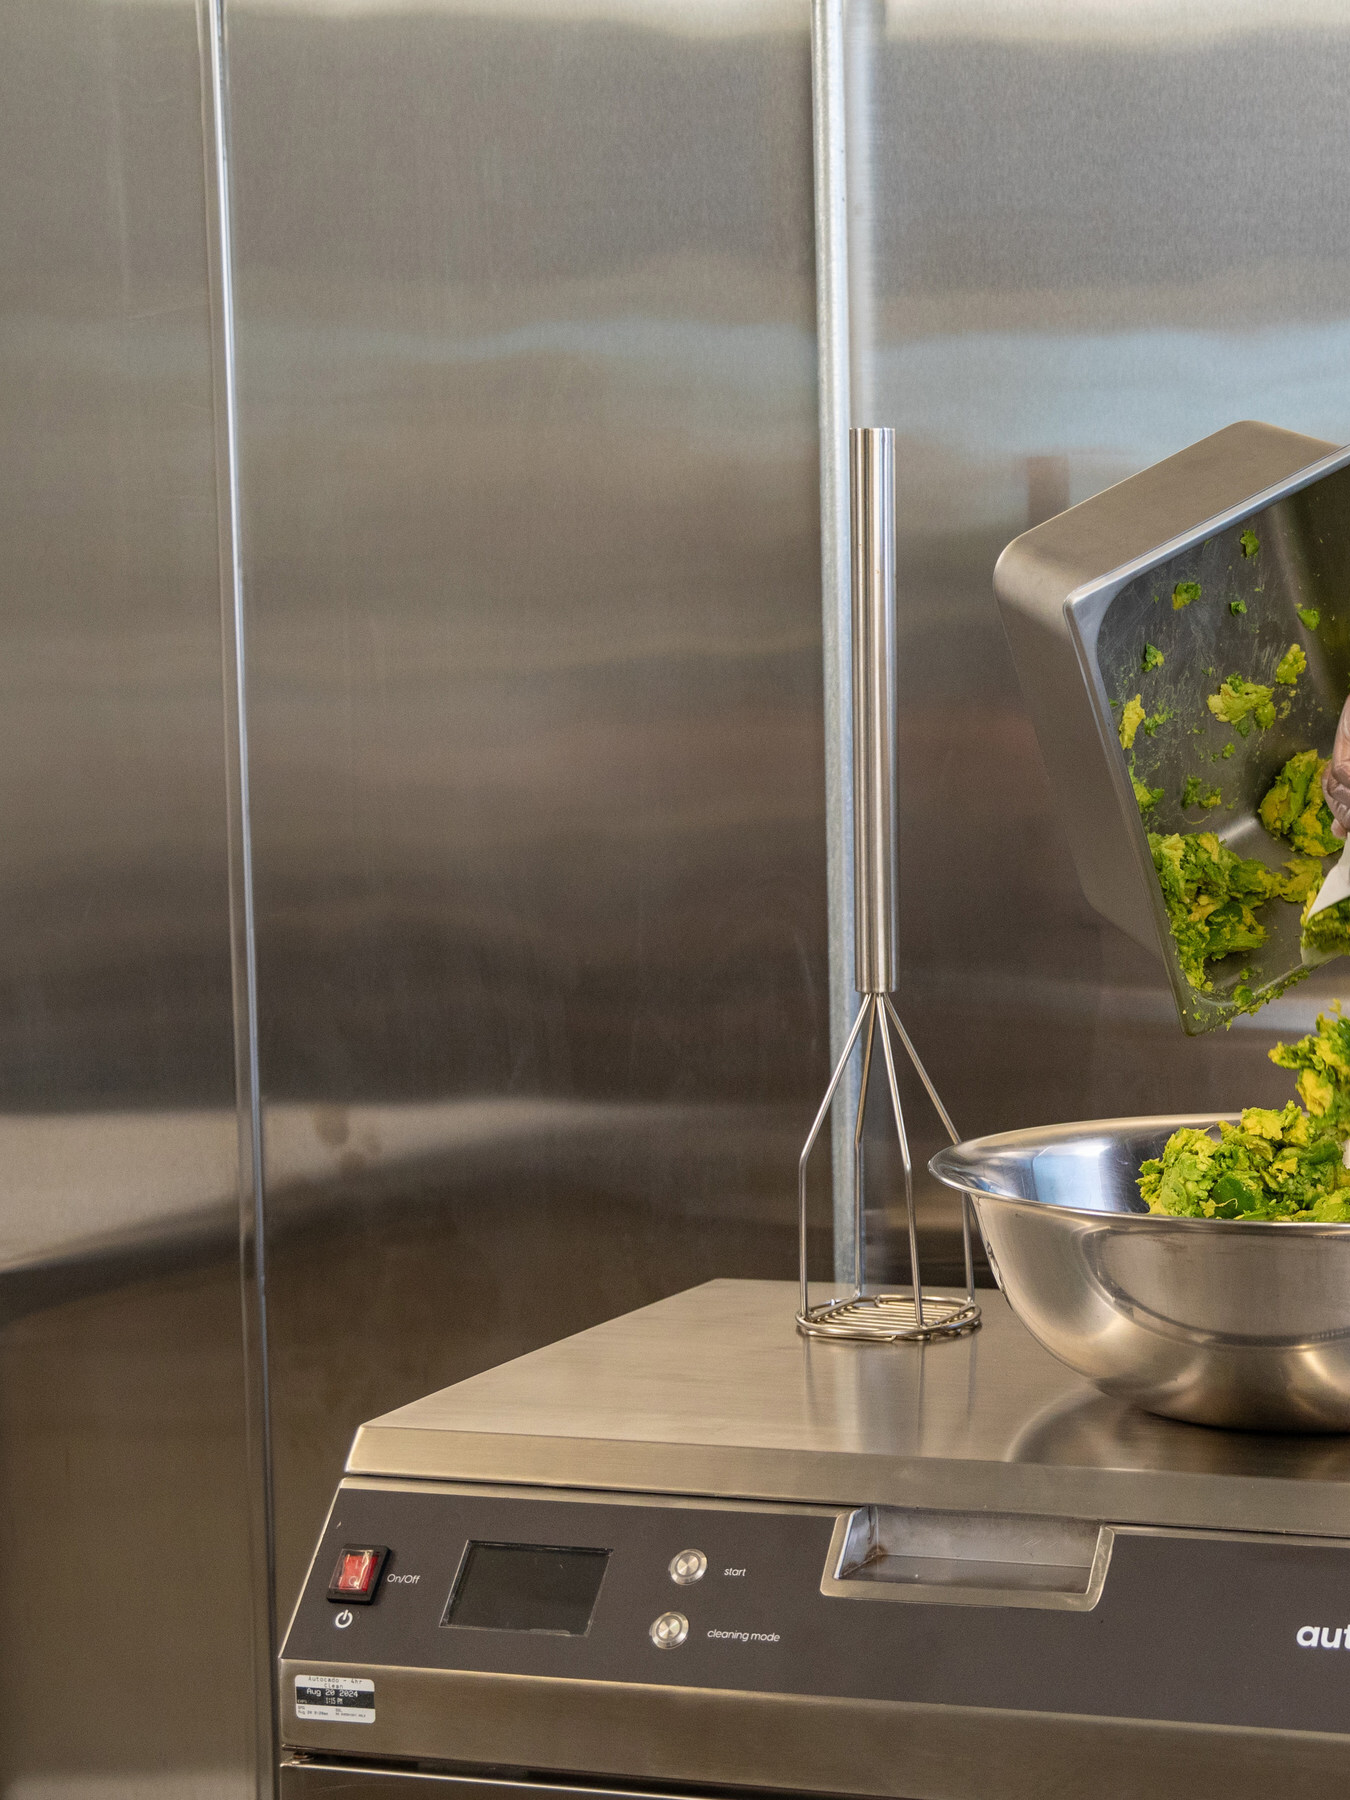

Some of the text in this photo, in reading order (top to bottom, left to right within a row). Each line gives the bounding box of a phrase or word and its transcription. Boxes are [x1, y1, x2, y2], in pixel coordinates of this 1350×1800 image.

[724, 1567, 746, 1577] start
[387, 1573, 421, 1584] On/Off
[707, 1629, 780, 1642] cleaning mode
[306, 1688, 358, 1697] Aug 20 2024
